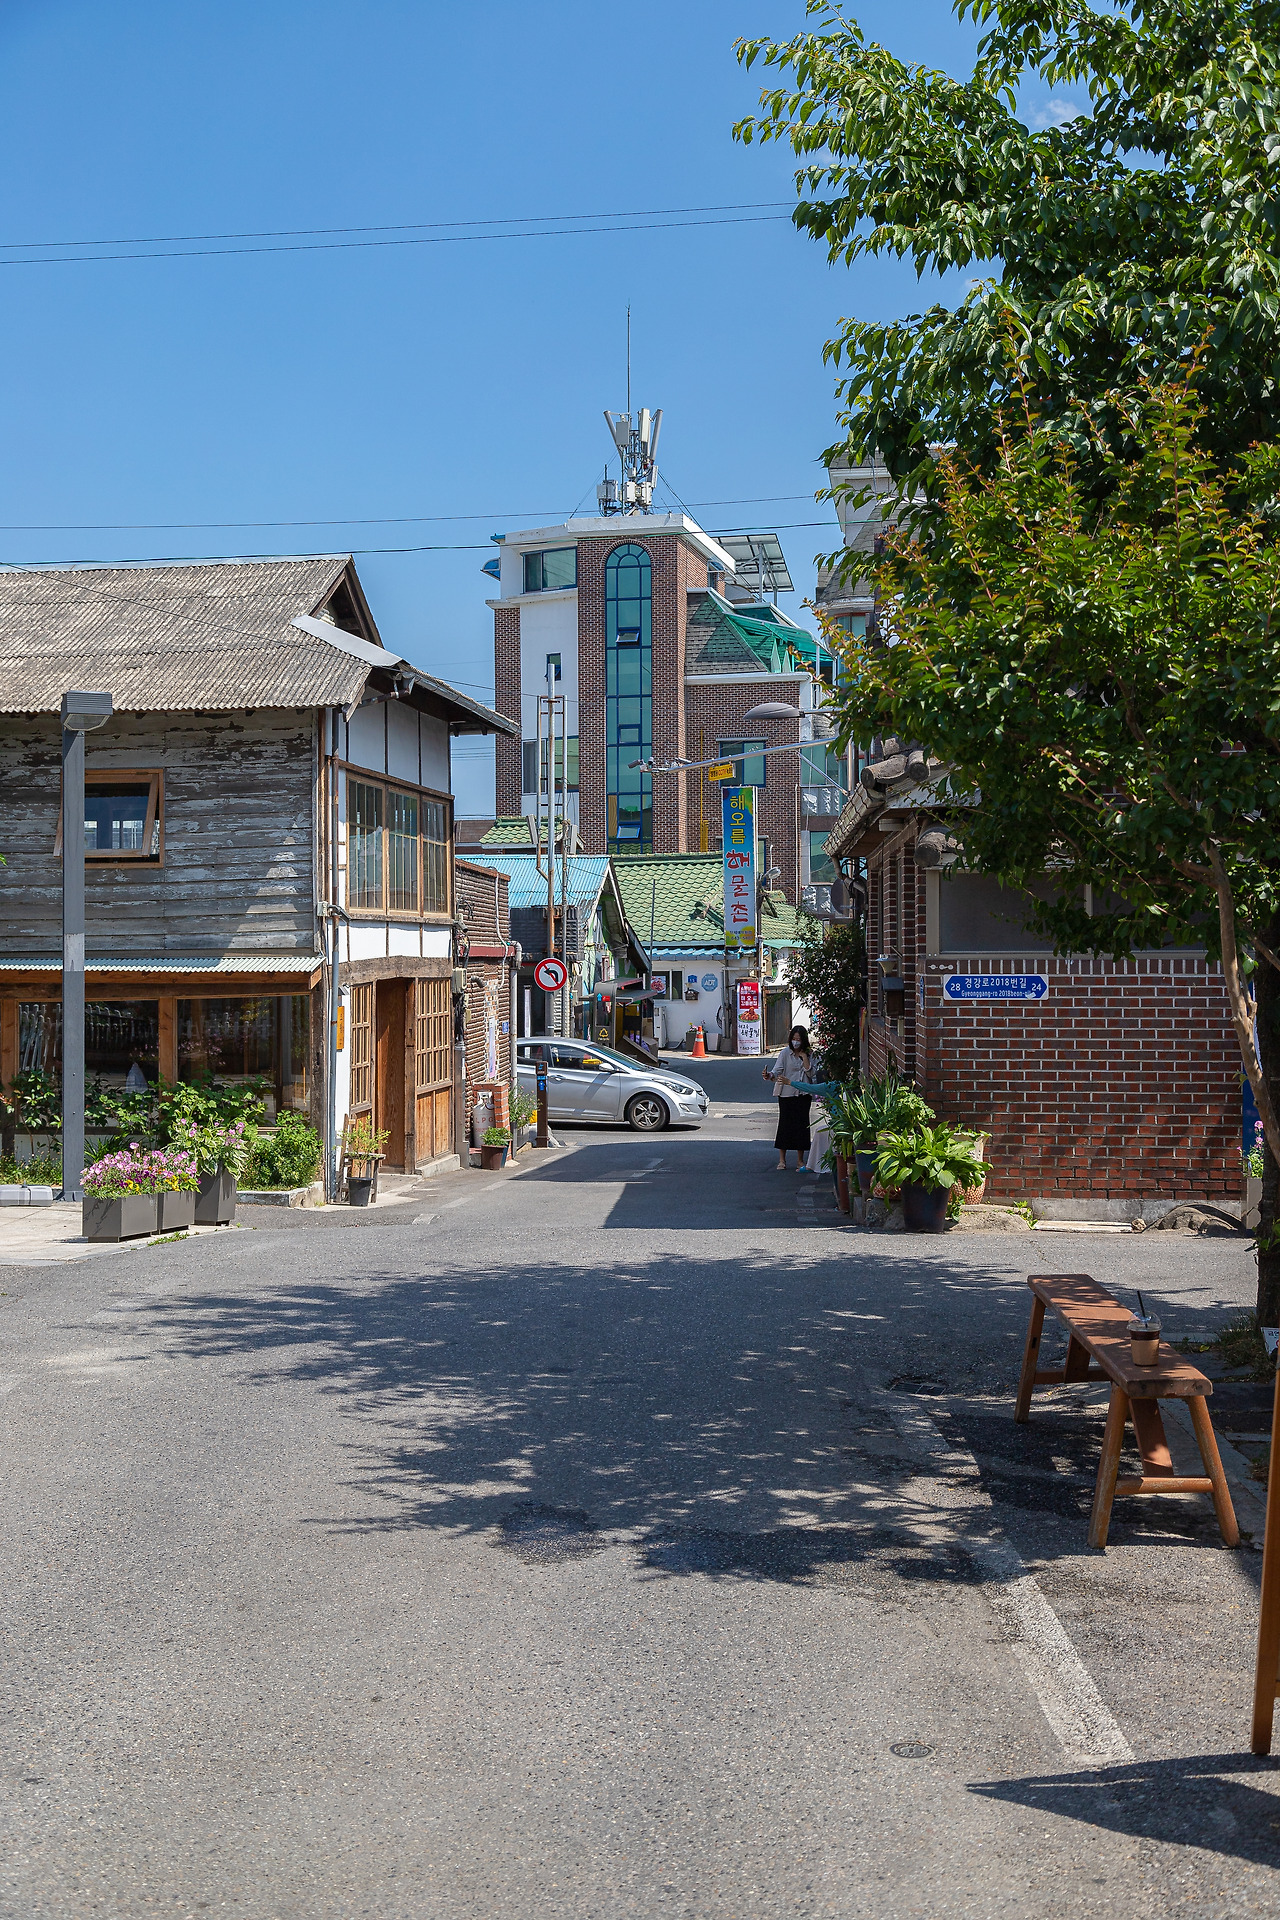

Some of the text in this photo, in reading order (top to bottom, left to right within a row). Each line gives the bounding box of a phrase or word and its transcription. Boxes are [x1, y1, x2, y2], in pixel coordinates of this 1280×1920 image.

[730, 794, 746, 844] 해오름
[965, 977, 1027, 988] 경강로2018번길
[950, 983, 961, 991] 28
[1031, 983, 1042, 991] 24
[961, 990, 998, 998] Gyeonggang-ro
